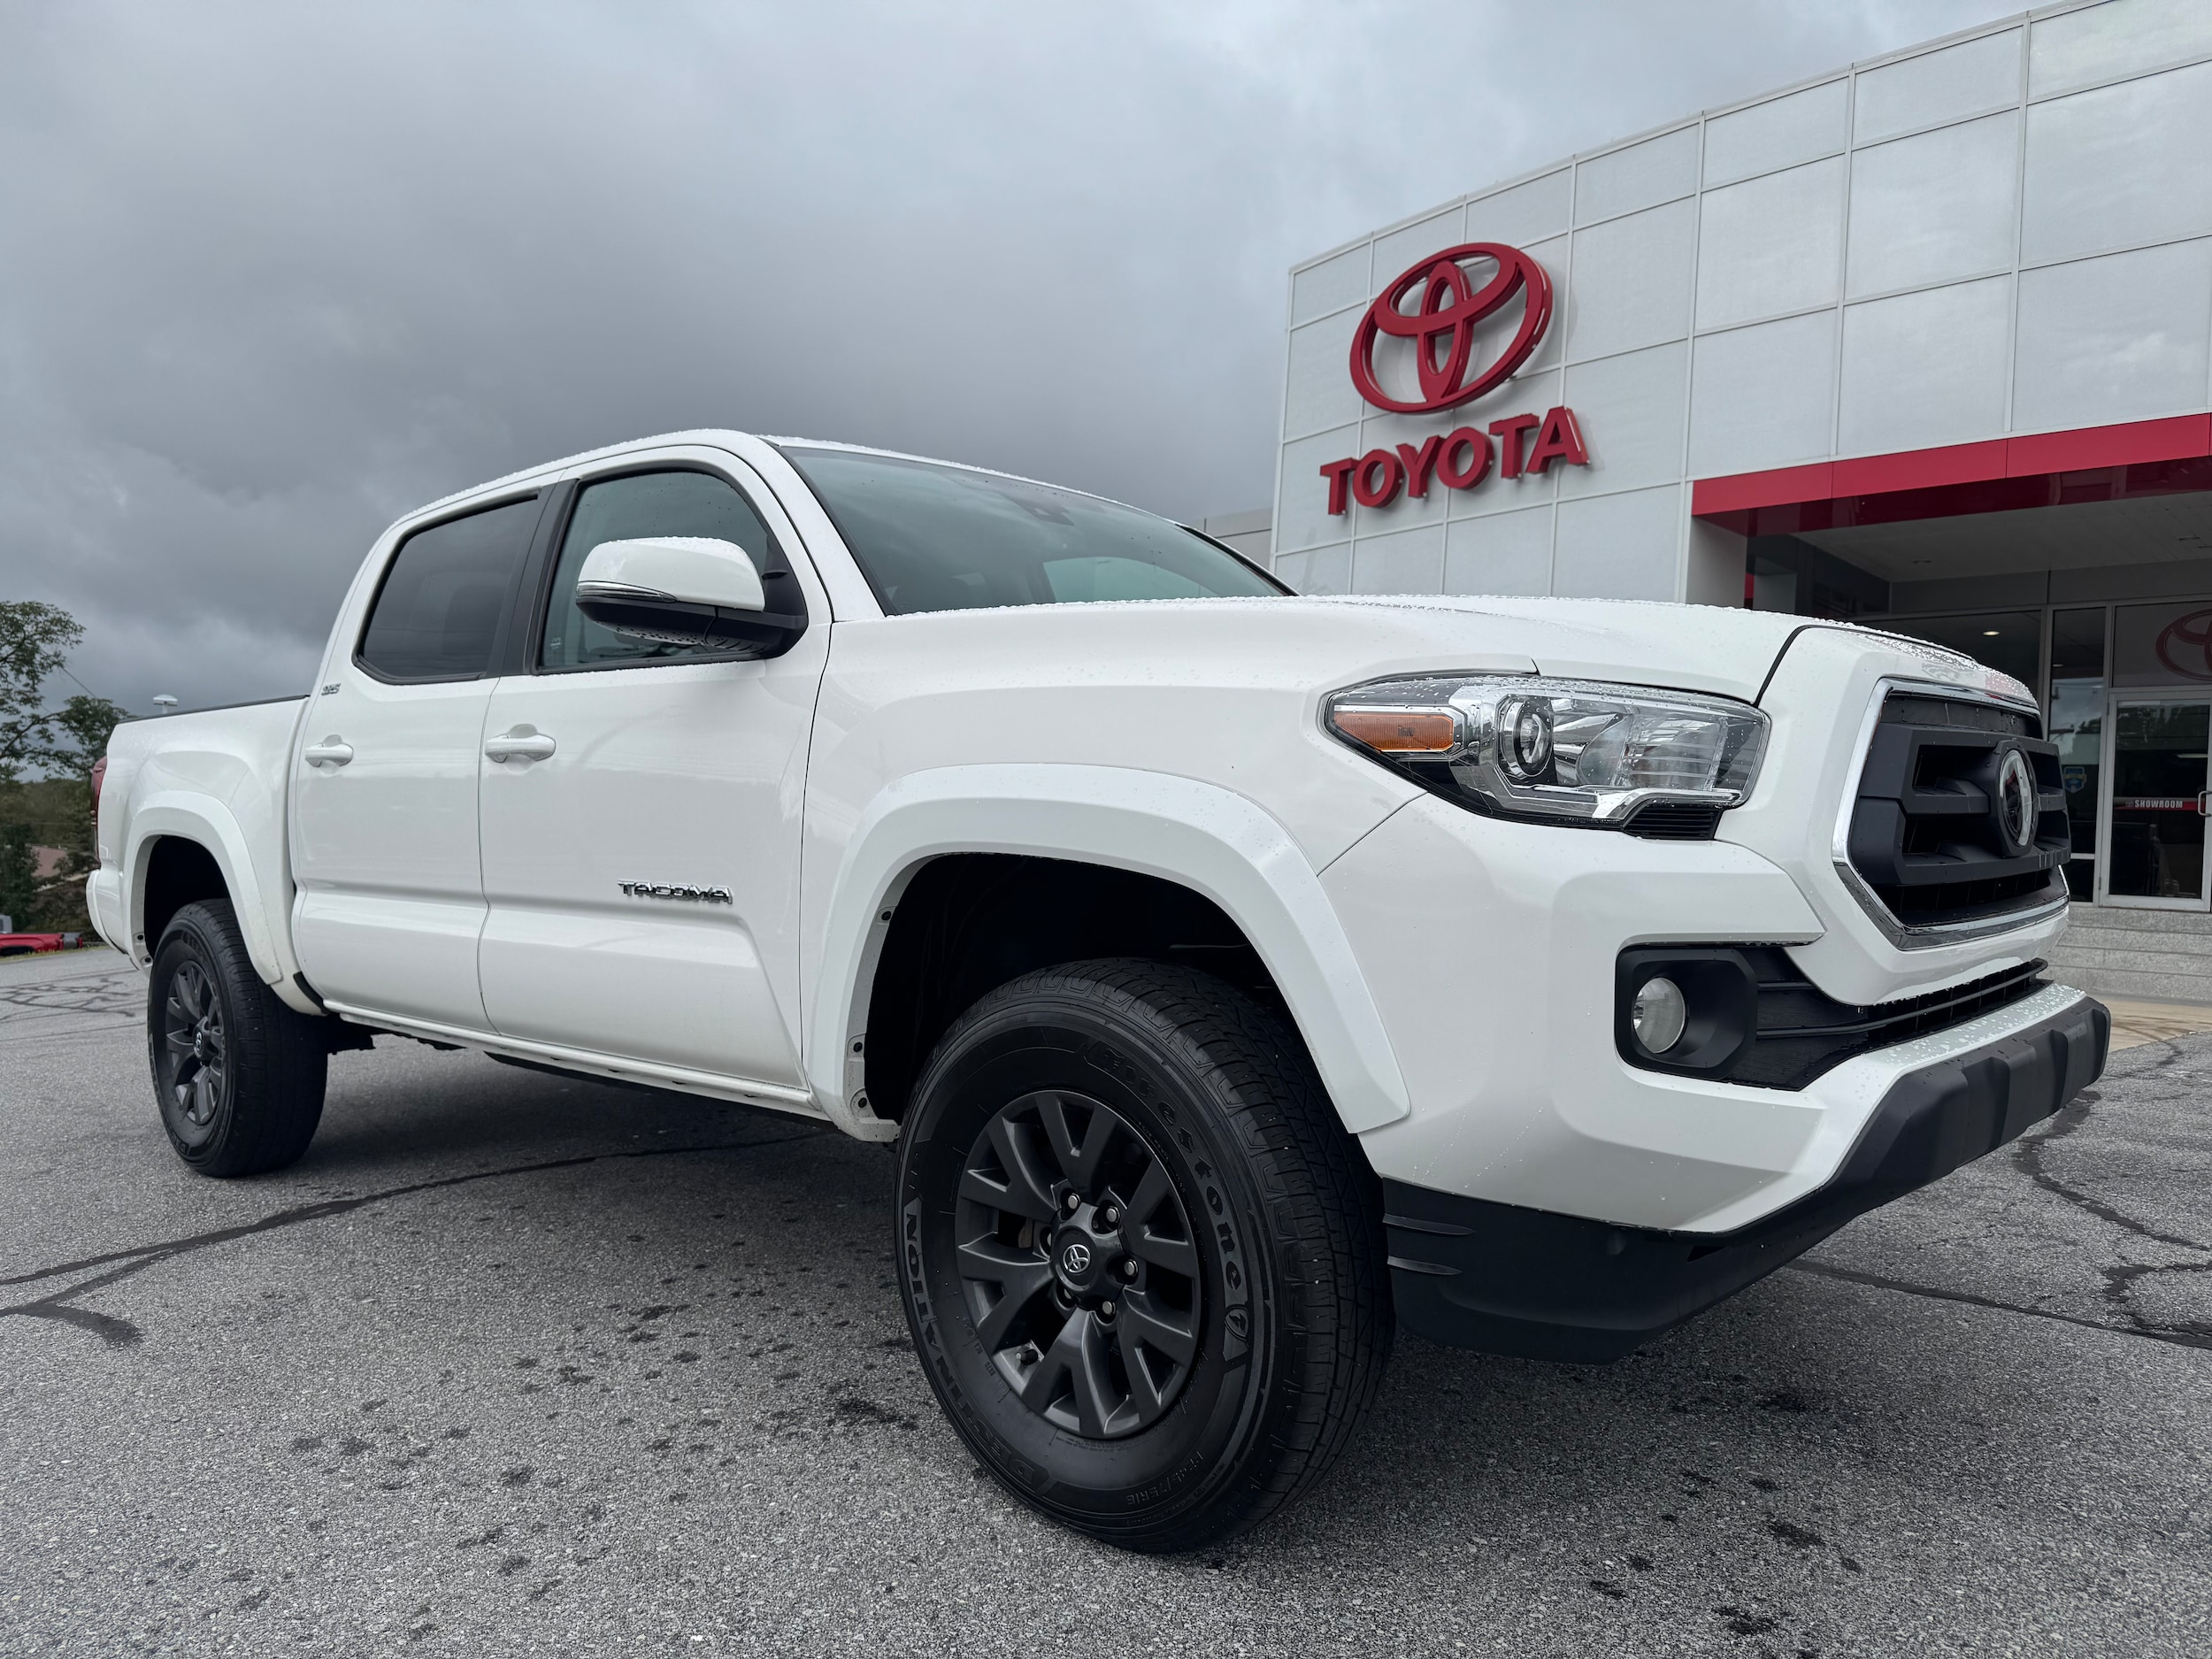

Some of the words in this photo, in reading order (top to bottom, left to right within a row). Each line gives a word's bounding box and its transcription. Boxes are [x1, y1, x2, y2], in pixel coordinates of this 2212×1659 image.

[1320, 405, 1590, 515] TOYOTA
[2134, 799, 2183, 809] SHOWROOM
[618, 880, 732, 904] TACOMA
[1105, 1046, 1242, 1291] Firestone
[905, 1212, 1037, 1486] DESTINATION
